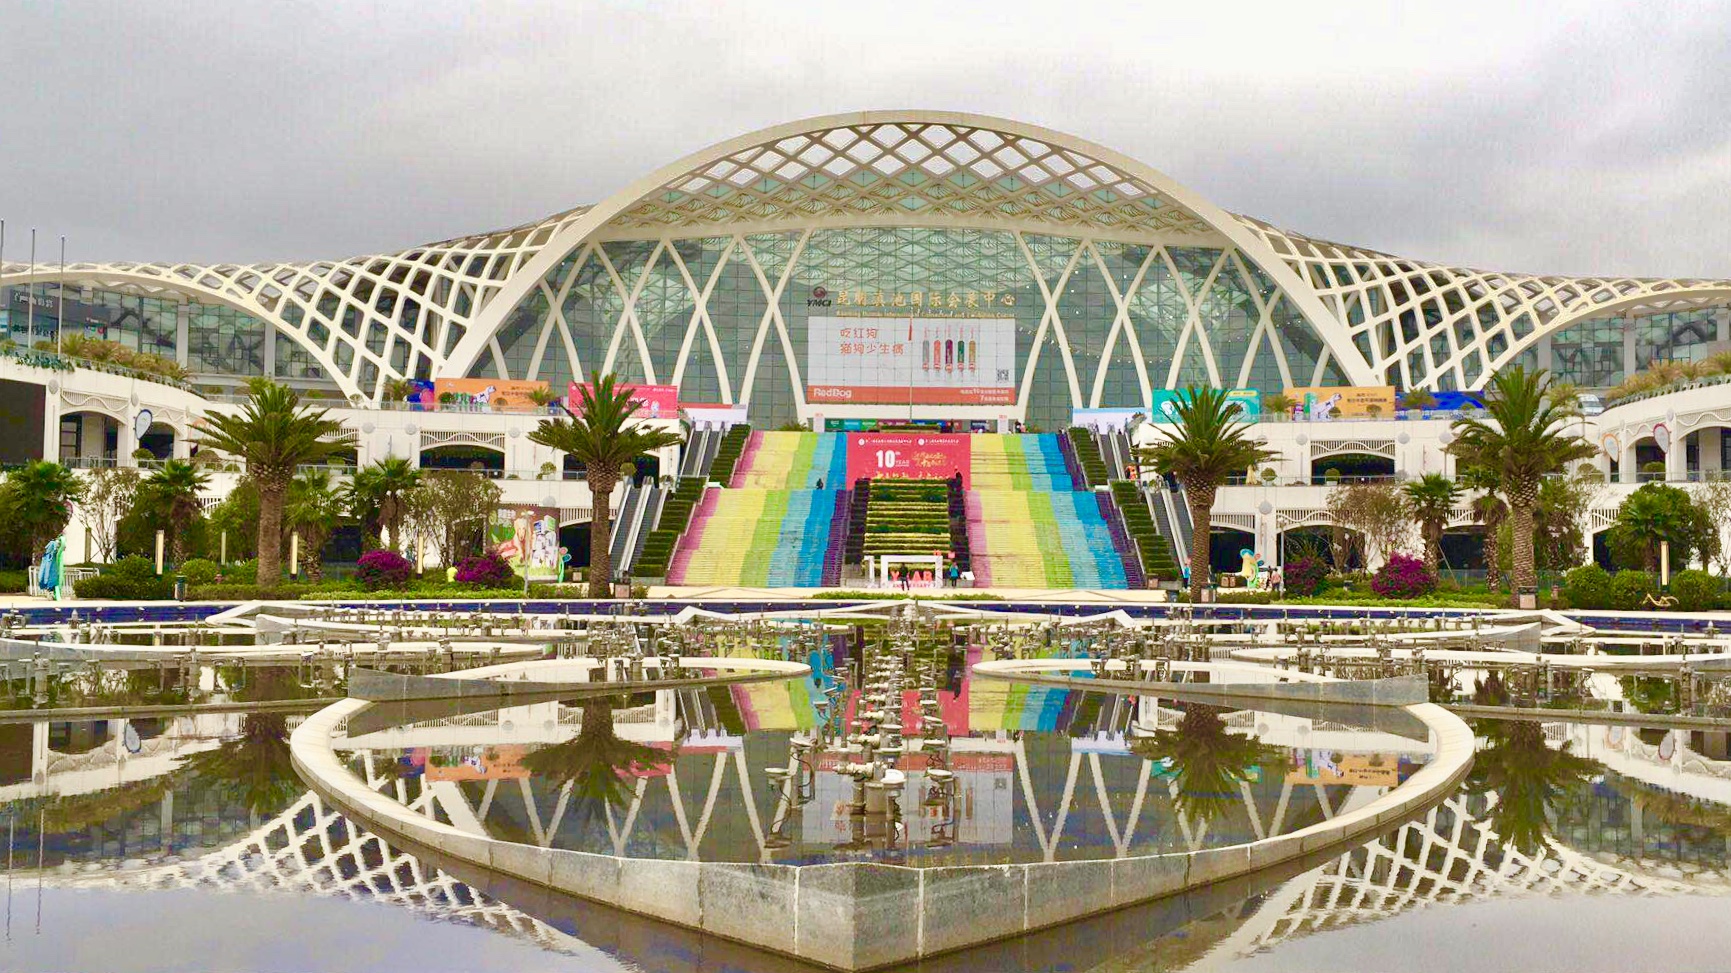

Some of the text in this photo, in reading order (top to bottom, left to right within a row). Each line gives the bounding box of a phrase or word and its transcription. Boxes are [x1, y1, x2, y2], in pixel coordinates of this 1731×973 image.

[807, 299, 832, 307] YMCI
[840, 327, 878, 339] 吃红狗
[840, 343, 904, 355] 猫狗少生病
[813, 388, 852, 398] RedDog
